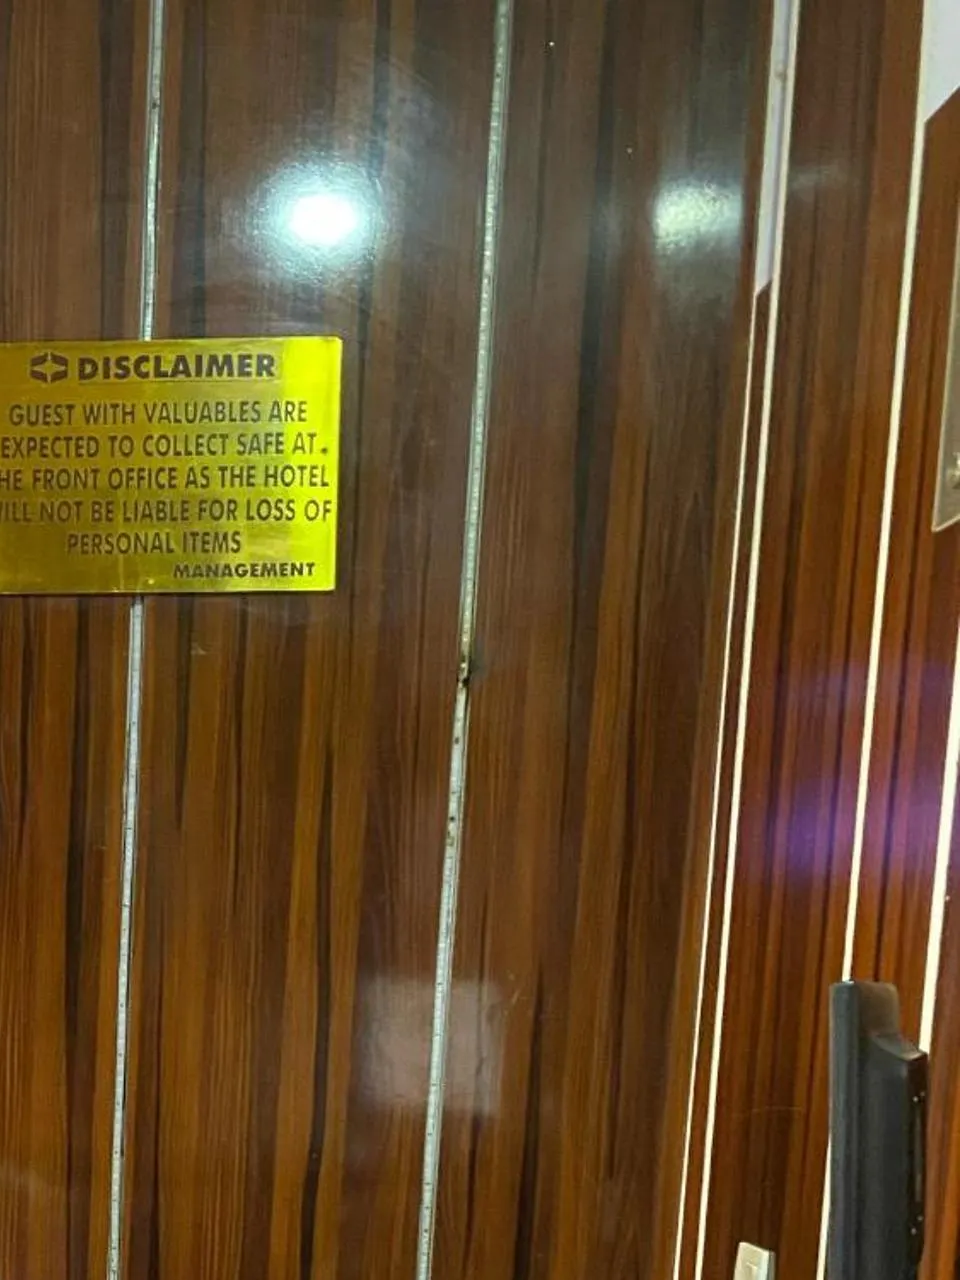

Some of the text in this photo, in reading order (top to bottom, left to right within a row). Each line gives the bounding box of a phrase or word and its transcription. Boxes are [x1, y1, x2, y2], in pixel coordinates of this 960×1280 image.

[78, 354, 276, 381] DISCLAIMER
[10, 401, 308, 426] GUEST WITH VALUABLES ARE
[1, 436, 99, 459] EXPECTED
[108, 435, 133, 457] TO
[143, 433, 228, 456] COLLECT
[237, 432, 284, 456] SAFE
[32, 468, 99, 490] FRONT
[108, 467, 177, 489] OFFICE
[185, 466, 209, 489] AS
[218, 466, 256, 488] THE
[264, 464, 329, 487] HOTEL
[42, 501, 82, 523] NOT
[91, 501, 114, 522] BE
[122, 501, 189, 522] LIABLE
[198, 500, 238, 522] FOR
[246, 499, 296, 521] LOSS
[304, 499, 332, 522] OF
[67, 531, 241, 554] PERSONAL ITEMS
[173, 562, 316, 579] MANAGEMENT
